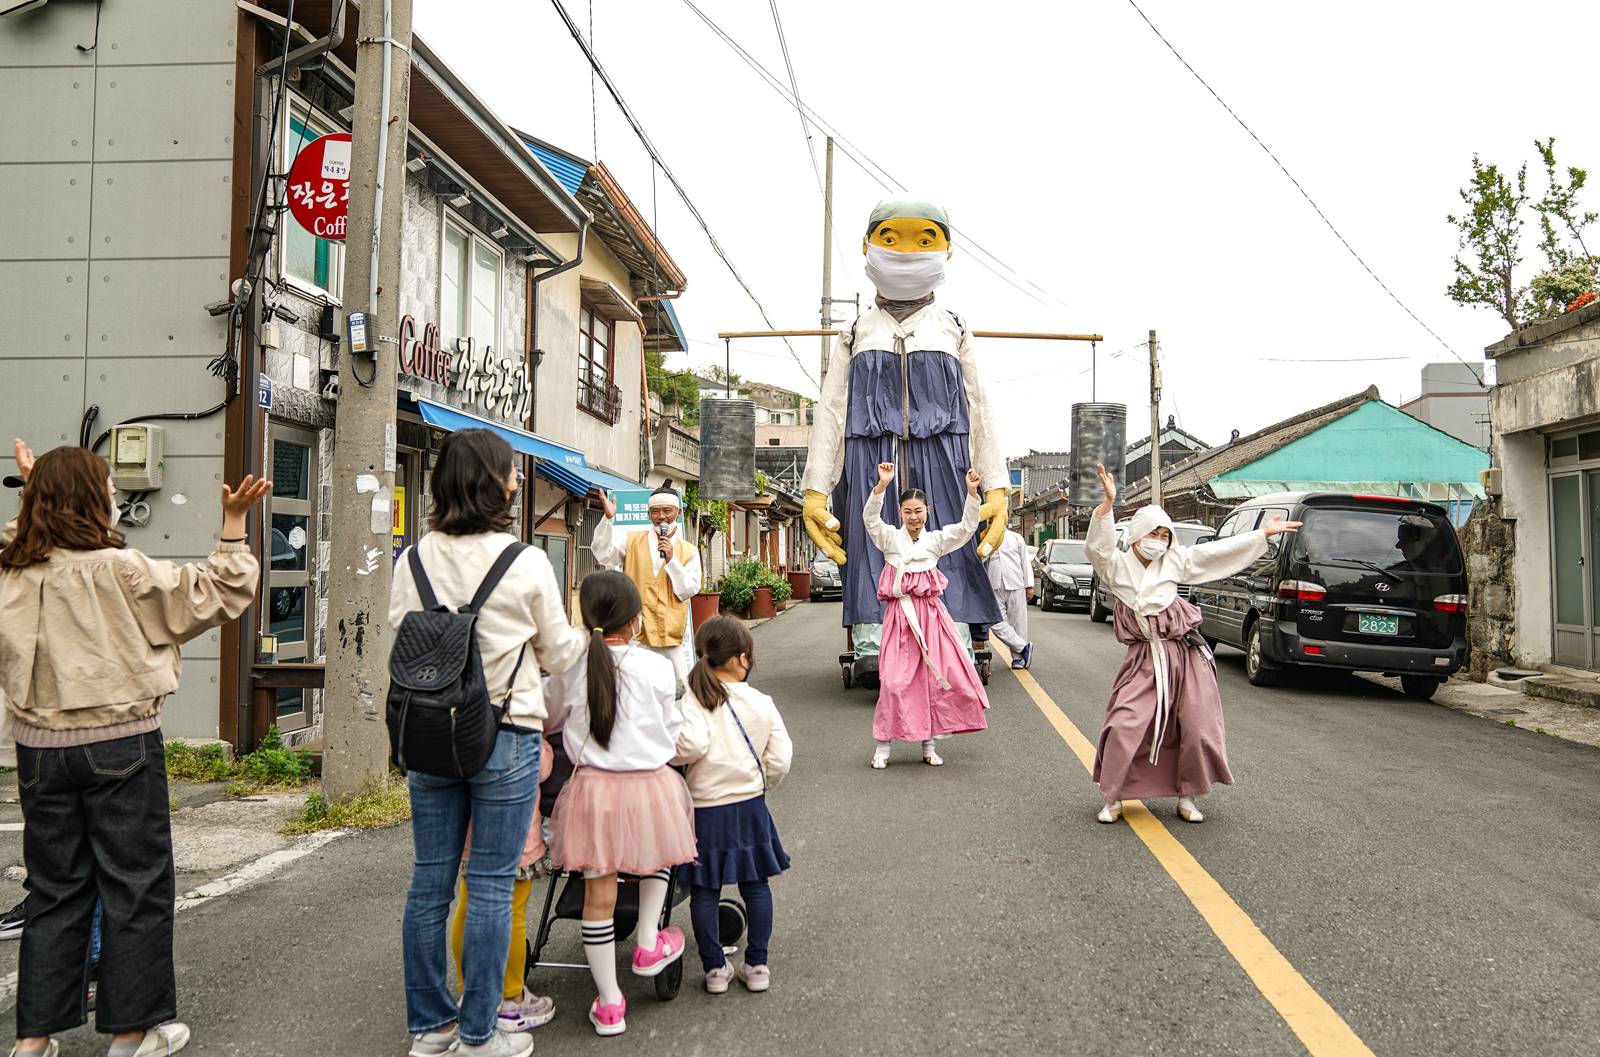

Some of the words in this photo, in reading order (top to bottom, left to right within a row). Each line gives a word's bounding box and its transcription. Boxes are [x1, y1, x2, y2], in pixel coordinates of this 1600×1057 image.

[324, 165, 346, 175] 작은공간
[399, 314, 451, 388] Coffee
[454, 336, 532, 423] 작은공간
[1361, 619, 1396, 633] 2823
